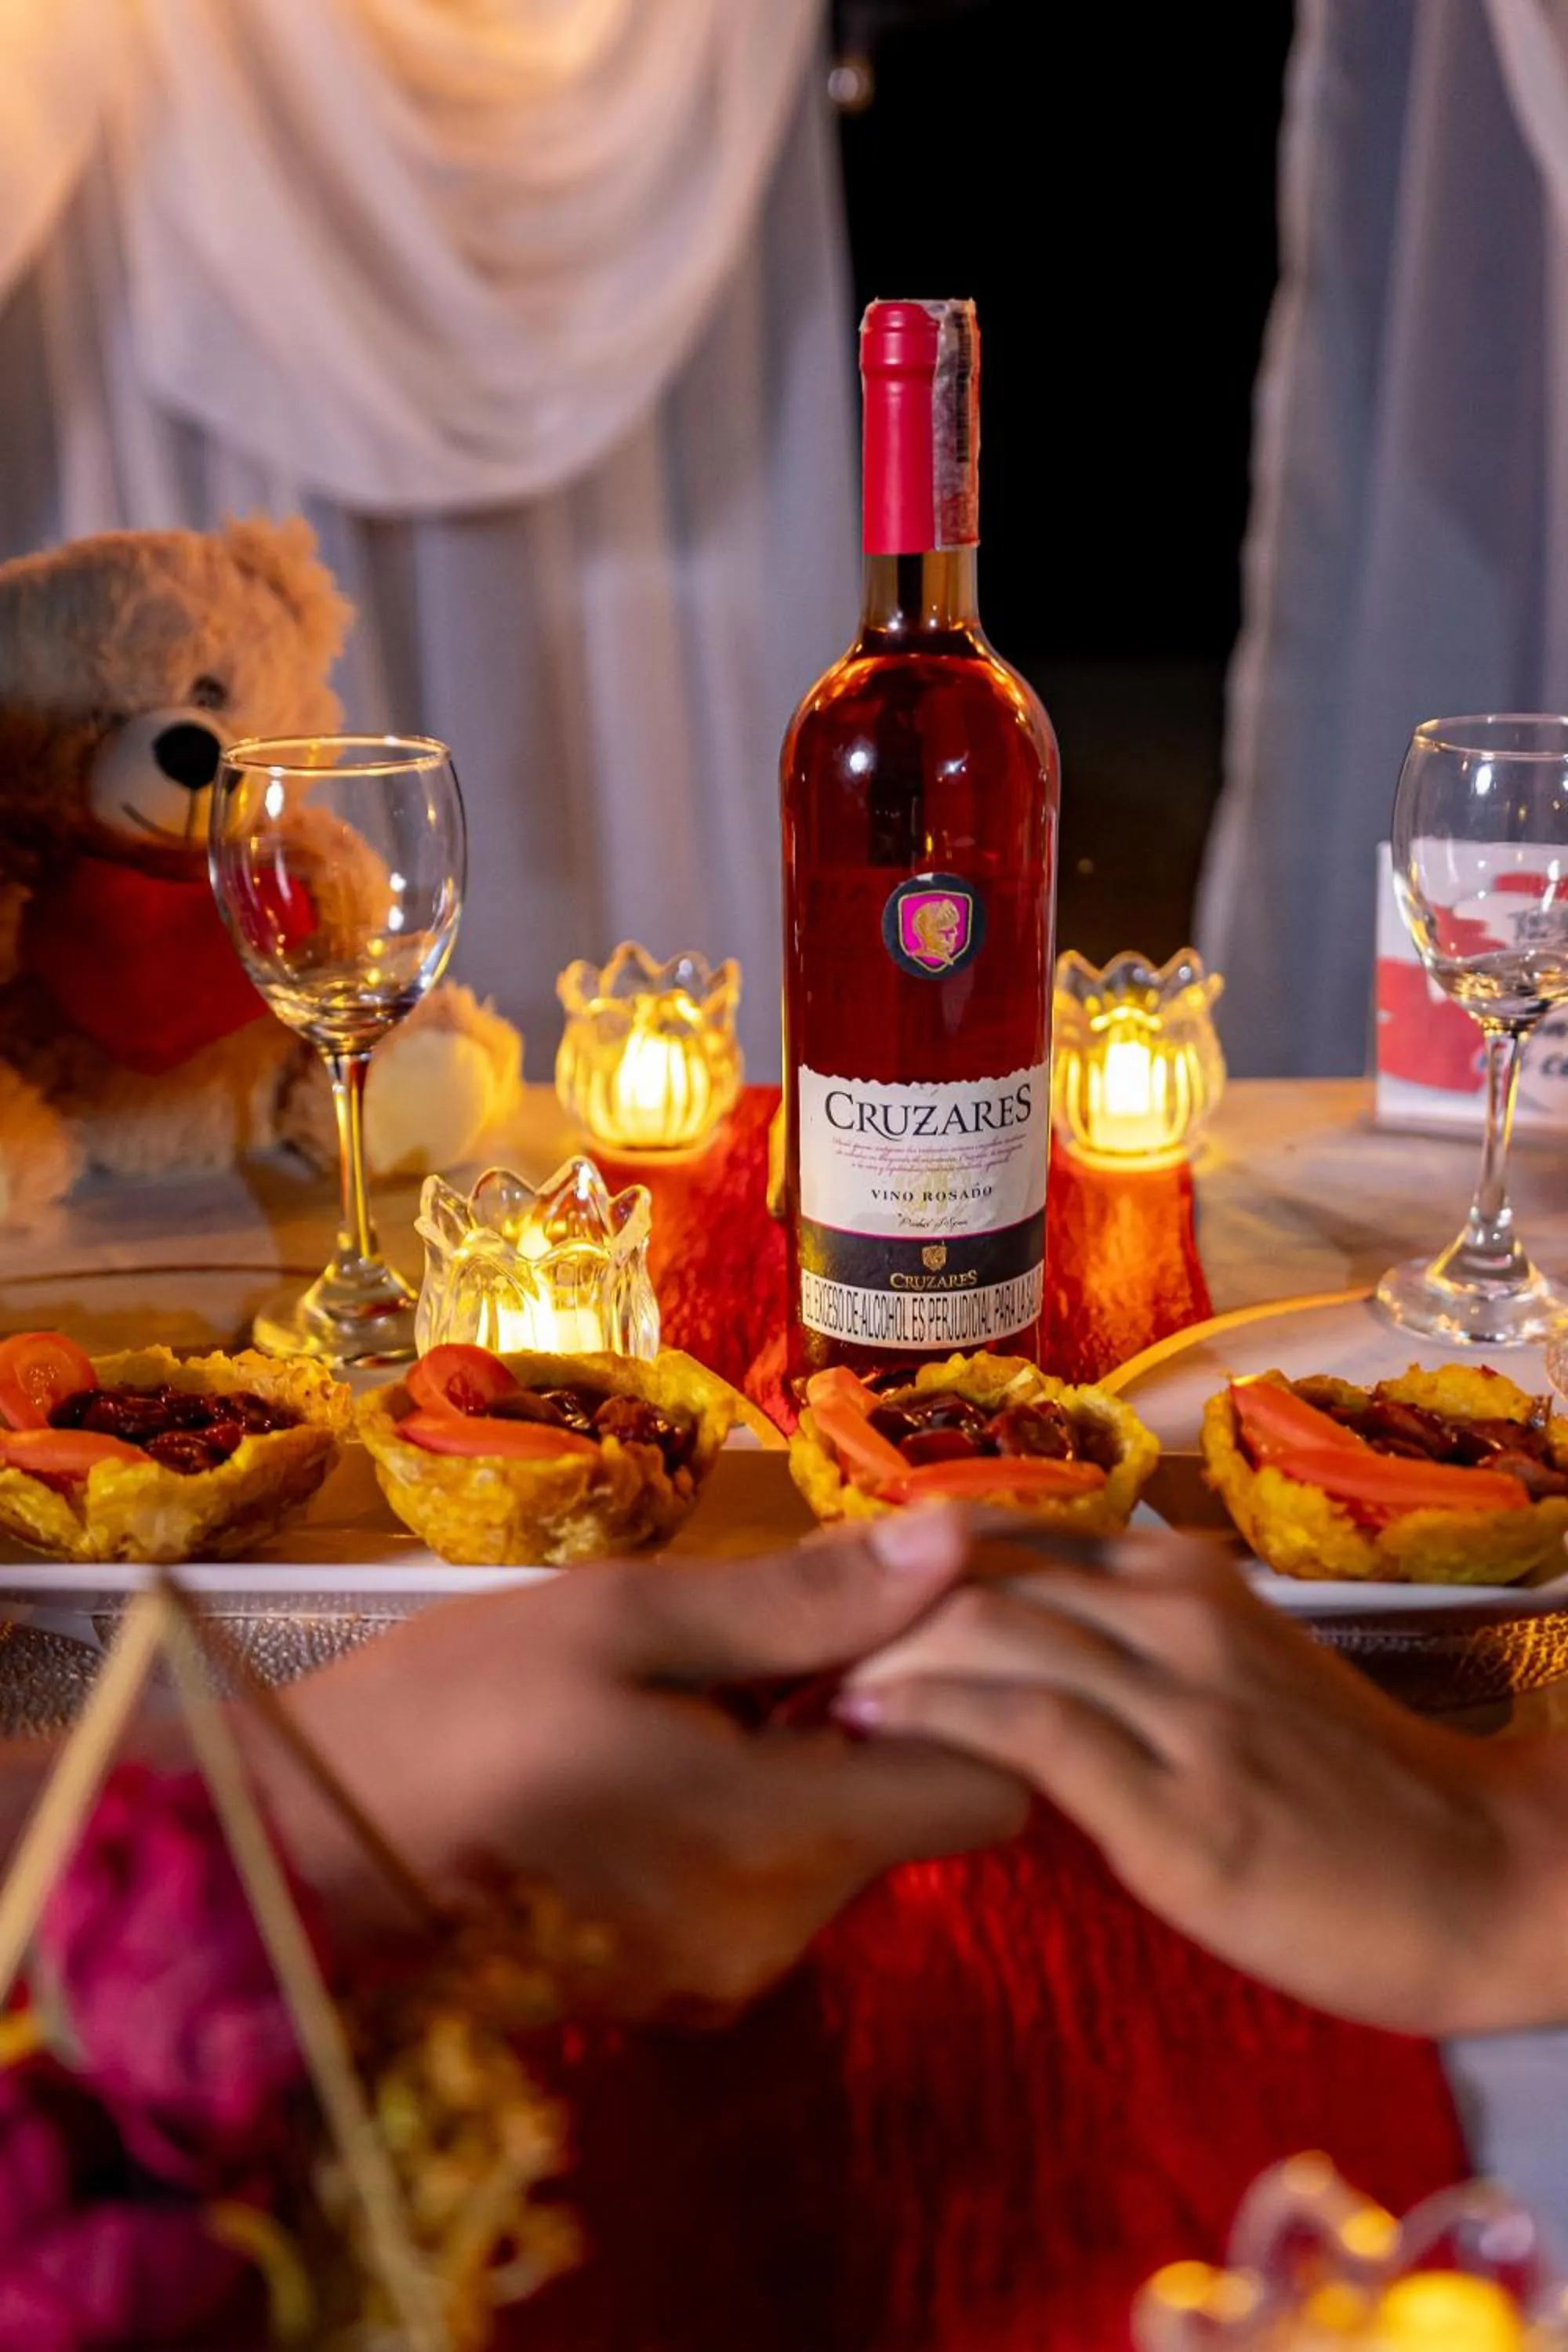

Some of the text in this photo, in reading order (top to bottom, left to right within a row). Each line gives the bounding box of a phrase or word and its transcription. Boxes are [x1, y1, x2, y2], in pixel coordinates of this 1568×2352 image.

[824, 1083, 1032, 1142] CRUZARES
[871, 1185, 993, 1202] VINO ROSADO
[890, 1269, 978, 1290] CRUZARES
[846, 1290, 858, 1335] DE
[861, 1293, 909, 1341] ALCOHOL
[912, 1296, 925, 1343] ES
